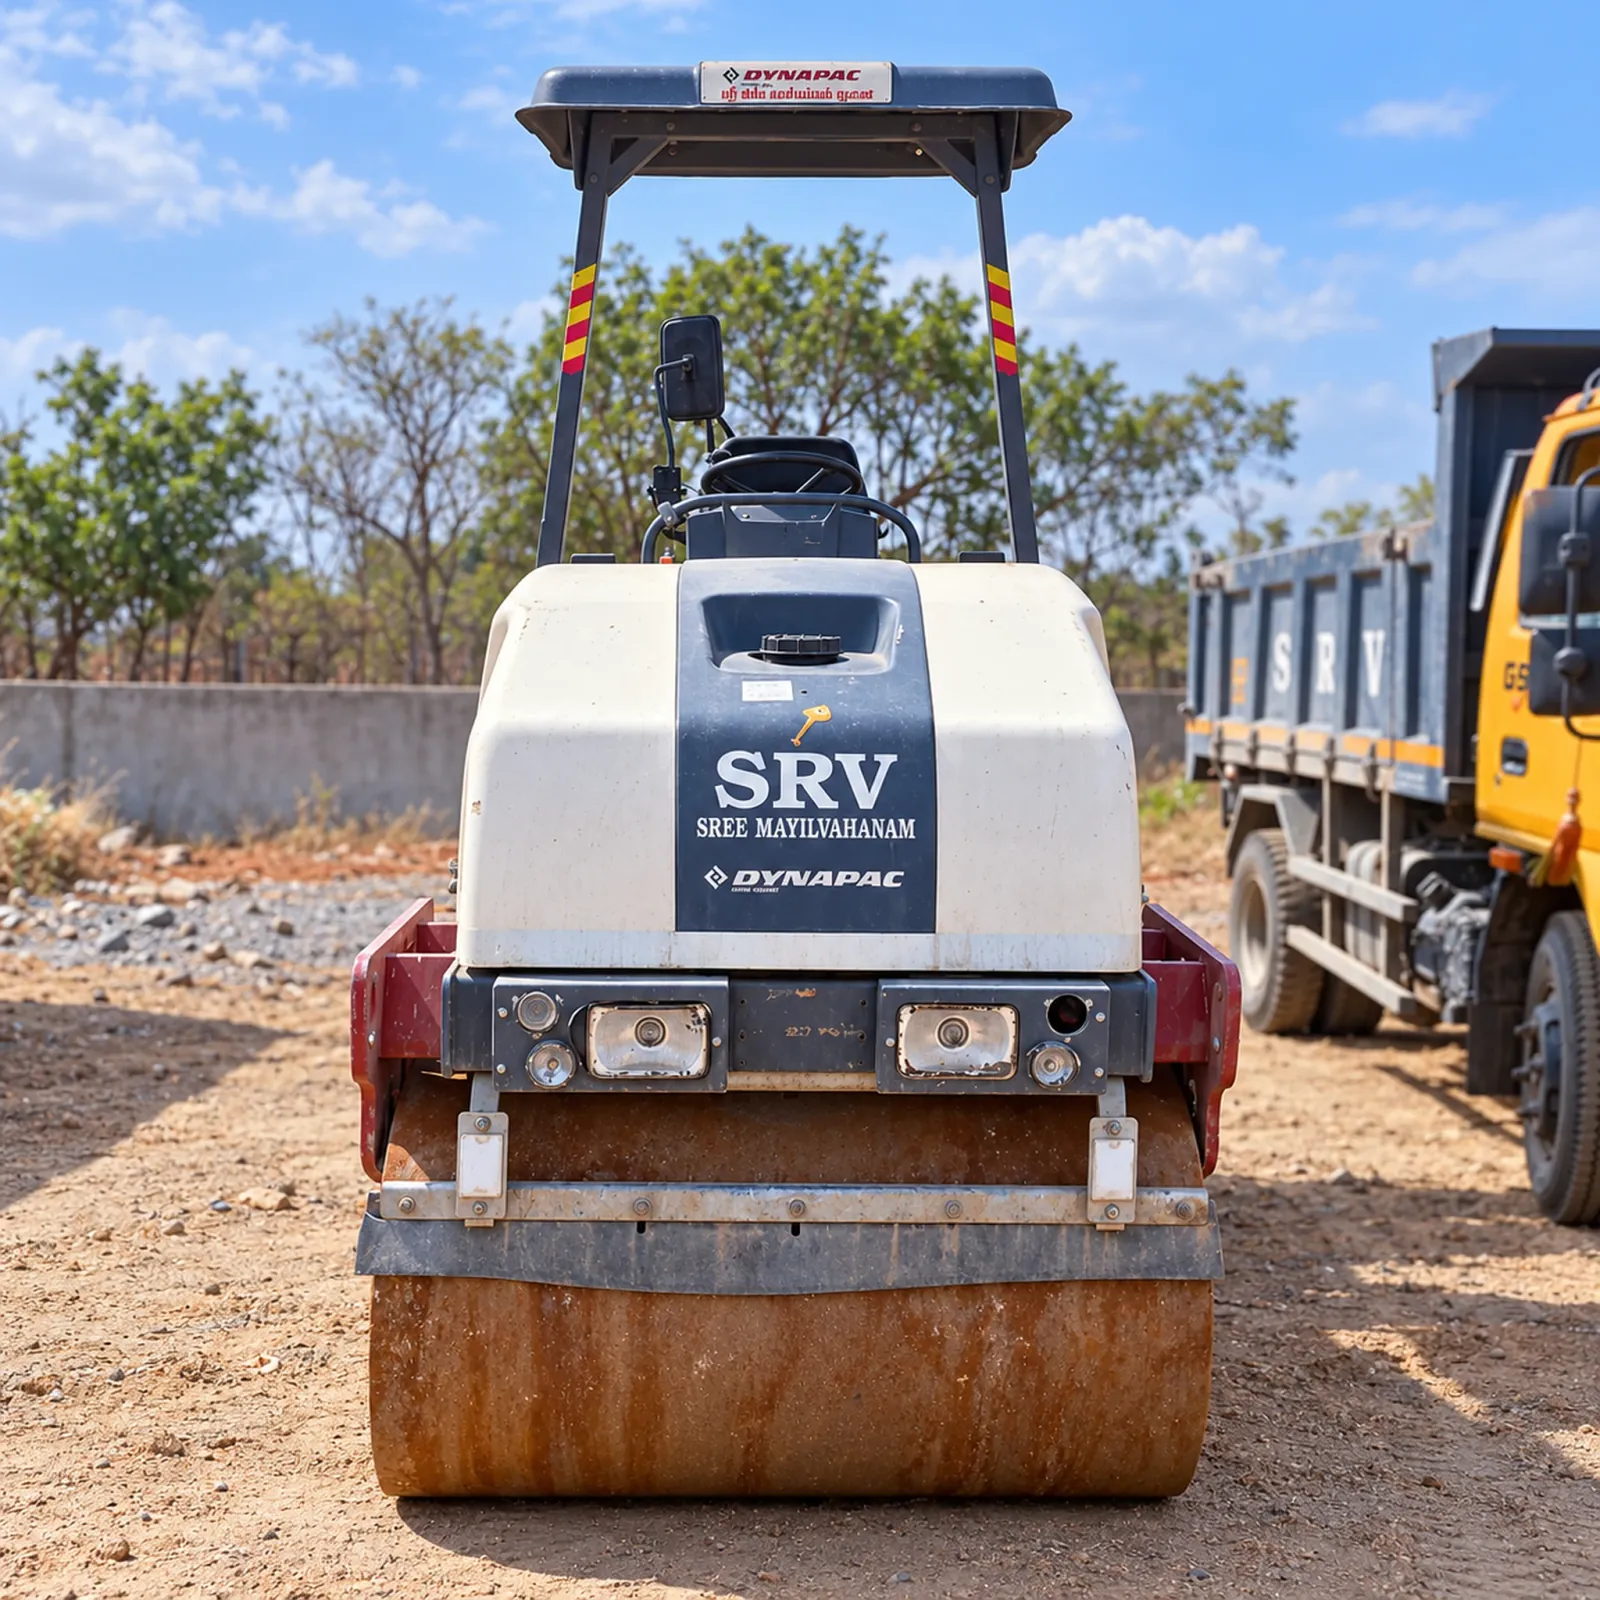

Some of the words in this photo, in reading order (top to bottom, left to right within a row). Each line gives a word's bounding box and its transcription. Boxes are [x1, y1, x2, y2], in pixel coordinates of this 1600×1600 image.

[743, 69, 861, 81] DYNAPAC
[714, 750, 898, 810] SRV
[696, 817, 749, 838] SREE
[755, 817, 916, 839] MAYILVAHANAM
[732, 870, 905, 888] DYNAPAC
